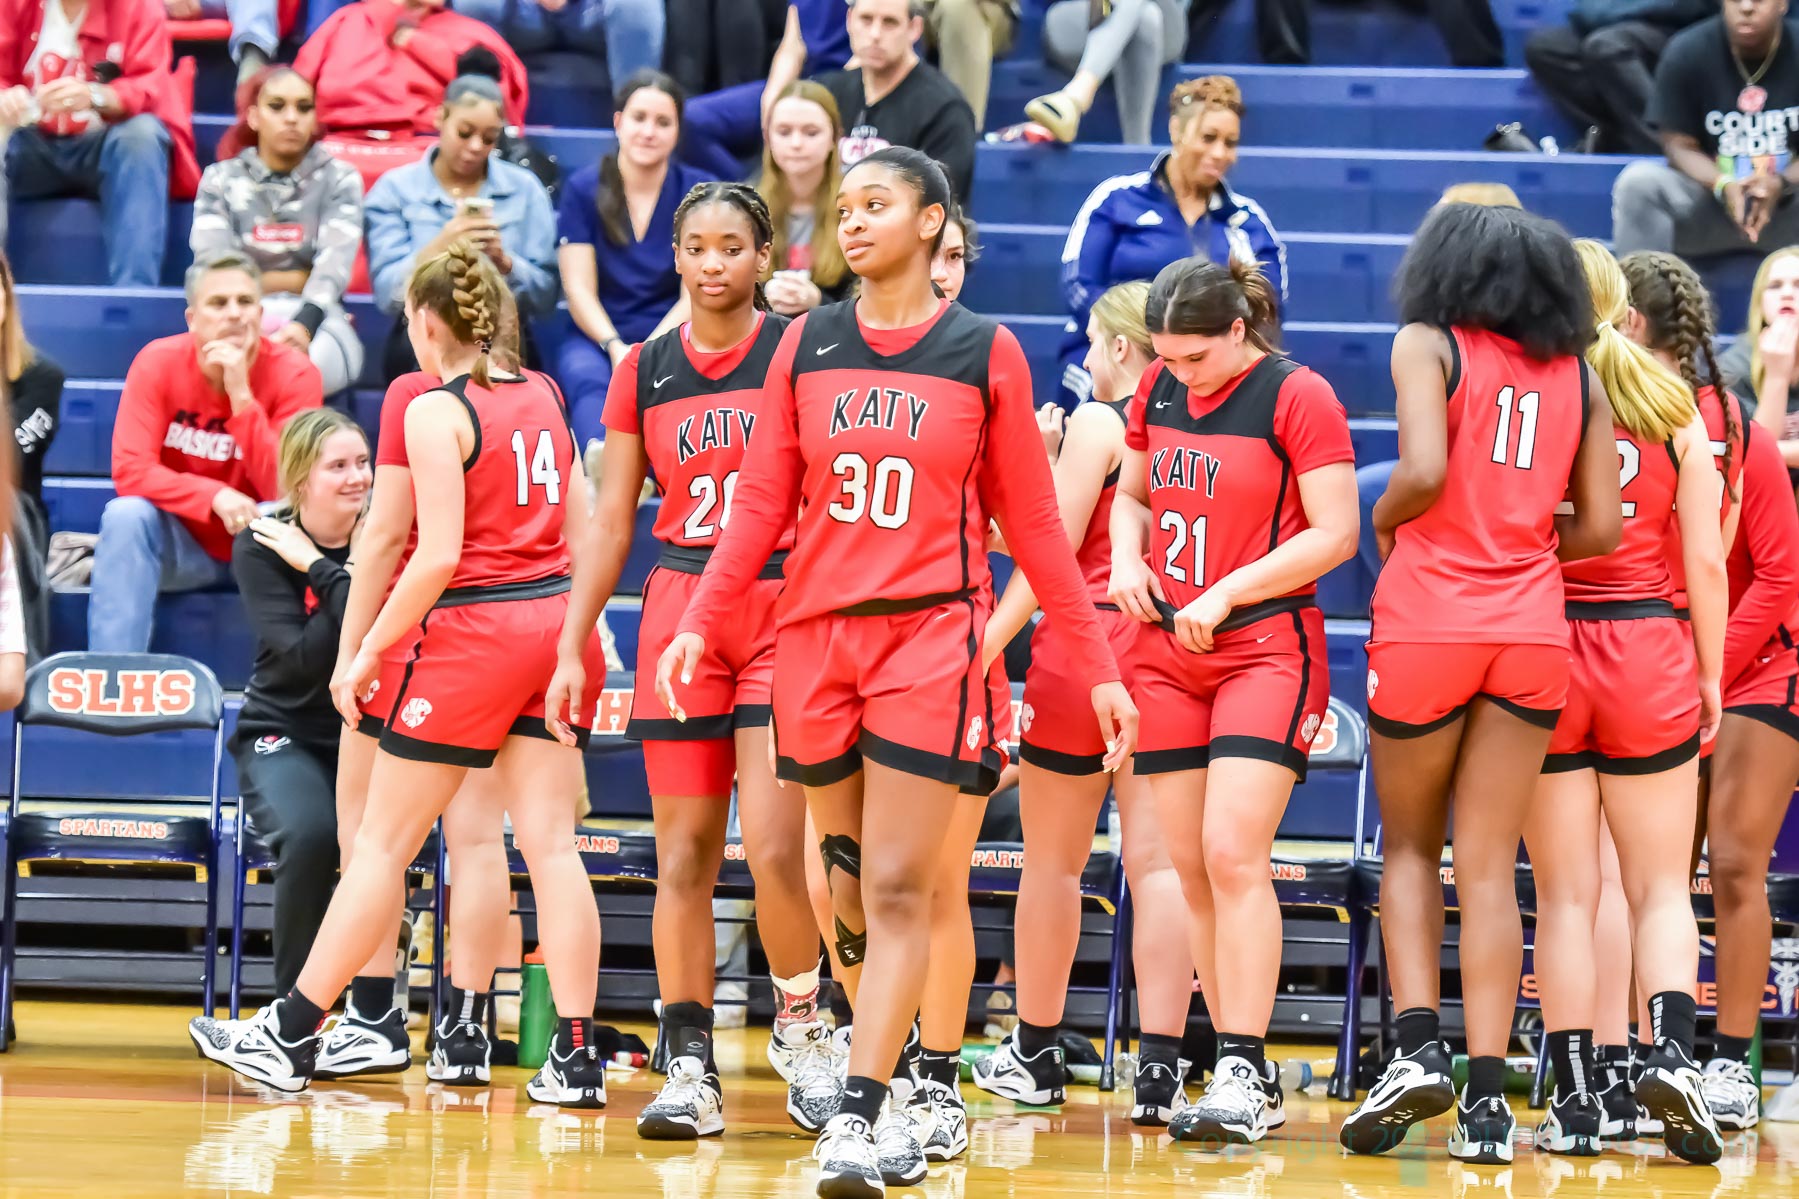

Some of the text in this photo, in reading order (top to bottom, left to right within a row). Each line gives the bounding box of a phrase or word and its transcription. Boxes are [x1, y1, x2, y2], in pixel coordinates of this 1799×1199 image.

[1705, 106, 1799, 135] COURT
[1718, 132, 1788, 157] SIDE
[677, 407, 756, 466] KATY
[829, 386, 928, 441] KATY
[1490, 384, 1540, 470] 11
[163, 422, 243, 462] BASKE
[510, 429, 561, 506] 14
[828, 452, 915, 530] 30
[1151, 446, 1222, 500] KATY
[1159, 508, 1208, 588] 21
[48, 667, 196, 717] SLHS
[58, 817, 169, 840] SPARTANS
